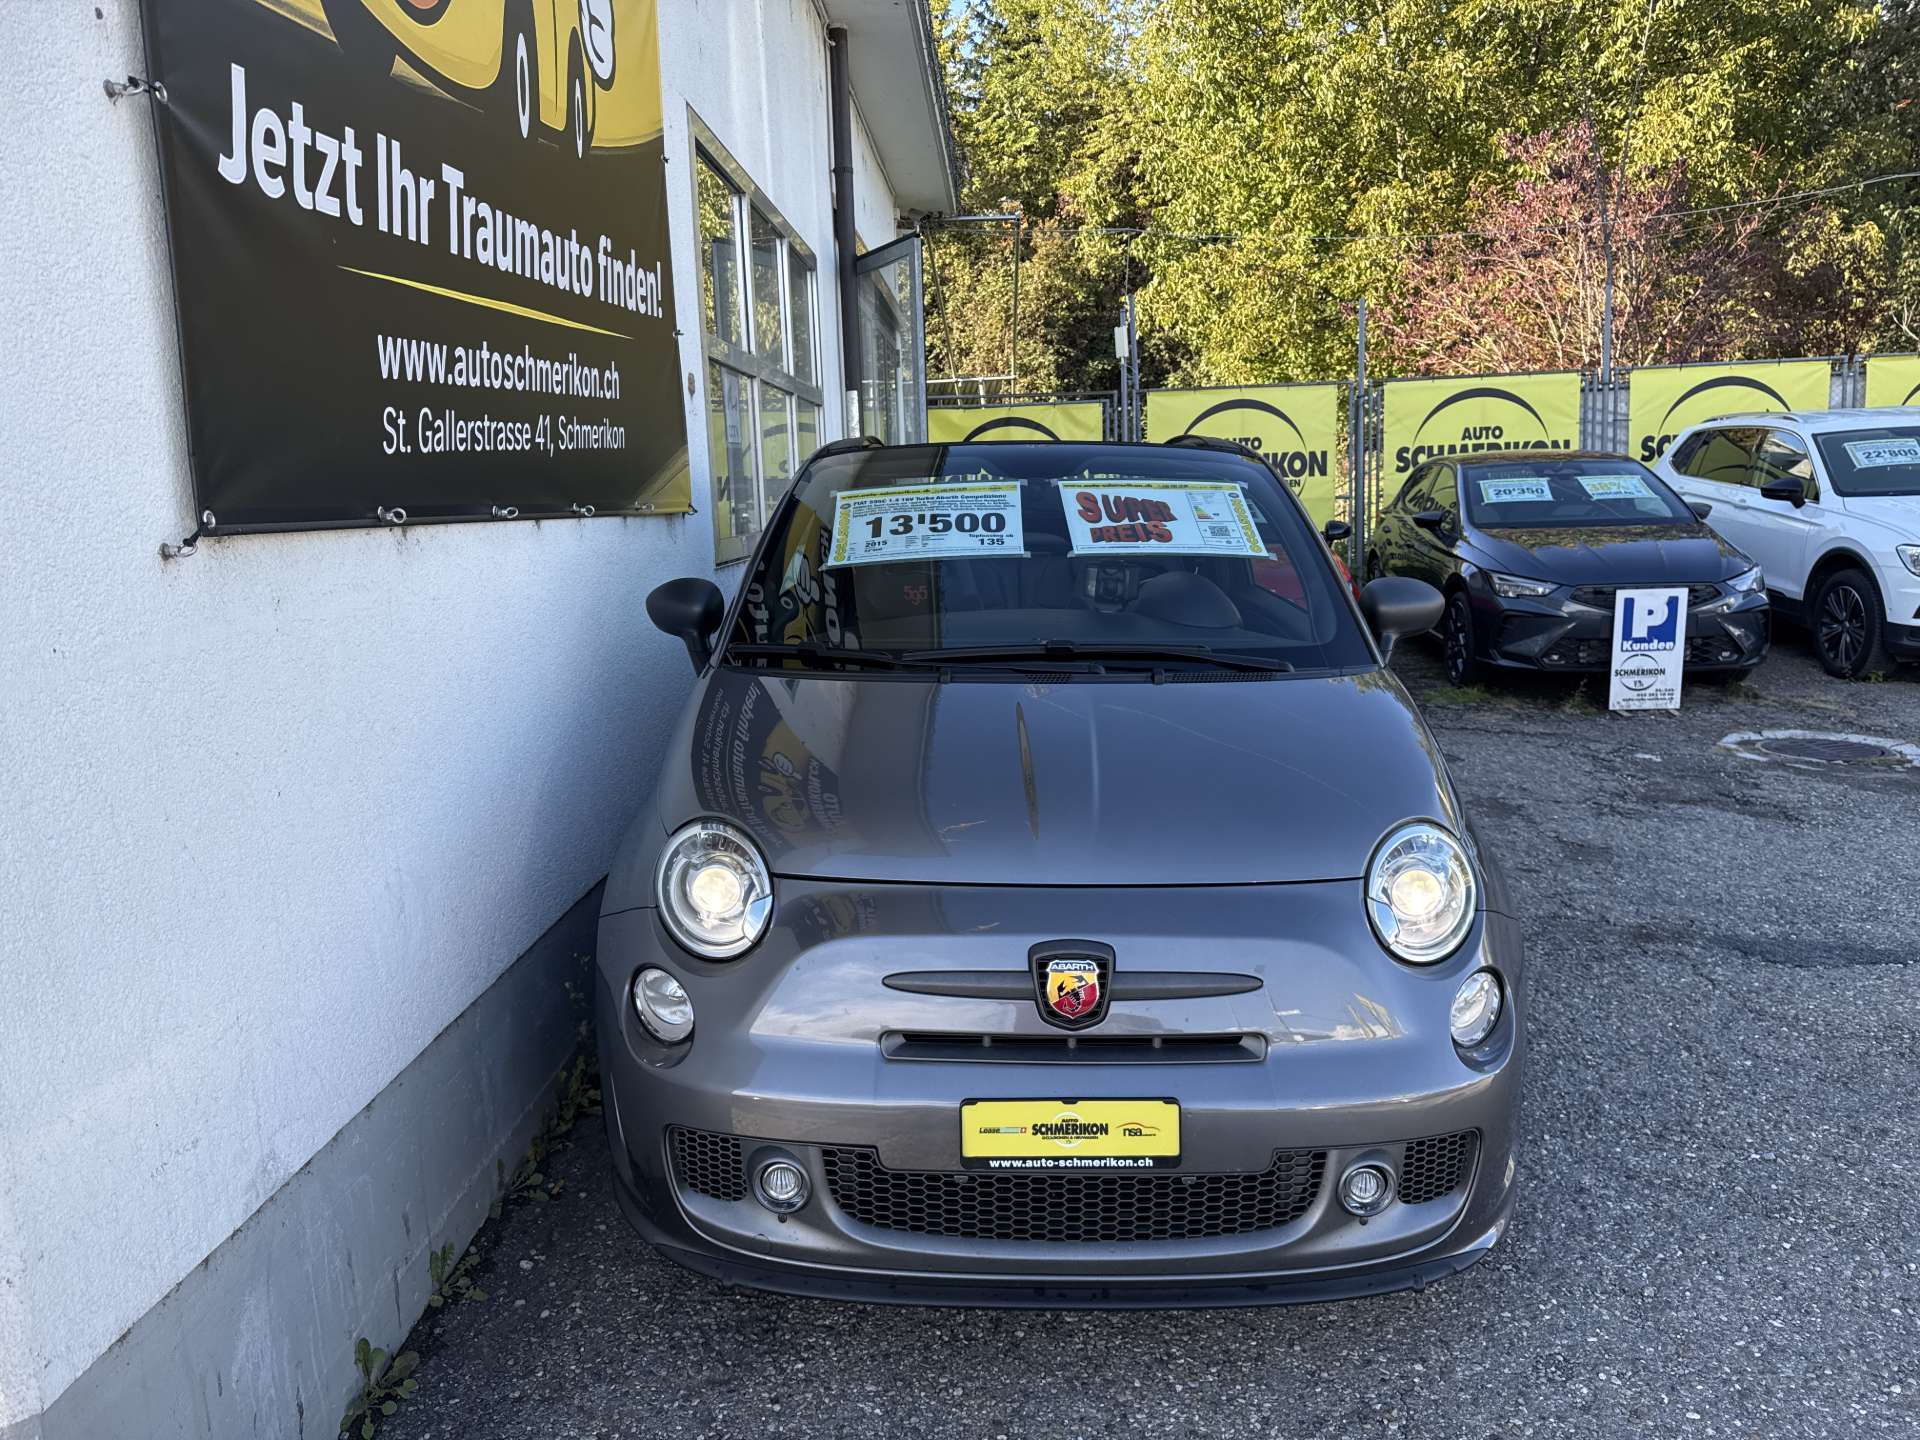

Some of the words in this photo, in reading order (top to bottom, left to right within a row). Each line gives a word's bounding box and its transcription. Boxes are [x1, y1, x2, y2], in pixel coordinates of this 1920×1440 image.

[217, 63, 363, 226] Jetzt
[376, 133, 435, 244] Ihr
[441, 163, 593, 297] Traumauto
[598, 234, 663, 318] finden!
[377, 334, 621, 400] www.autoschmerikon.ch
[382, 407, 411, 454] St.
[418, 407, 531, 454] Gallerstrasse
[535, 415, 554, 457] 41,
[558, 416, 625, 450] Schmerikon
[1461, 426, 1503, 441] AUTO
[1076, 491, 1178, 524] SUPER
[865, 513, 1006, 538] 13'500
[1089, 521, 1173, 543] PREIS
[865, 540, 888, 548] 2015
[1631, 597, 1669, 638] P
[1622, 639, 1674, 652] Kunden
[1614, 668, 1666, 677] SCHMERIKON
[1032, 1123, 1109, 1135] SCHMERIKON
[1123, 1127, 1142, 1136] nsa
[989, 1157, 1154, 1168] www.auto-schmerikon.ch
